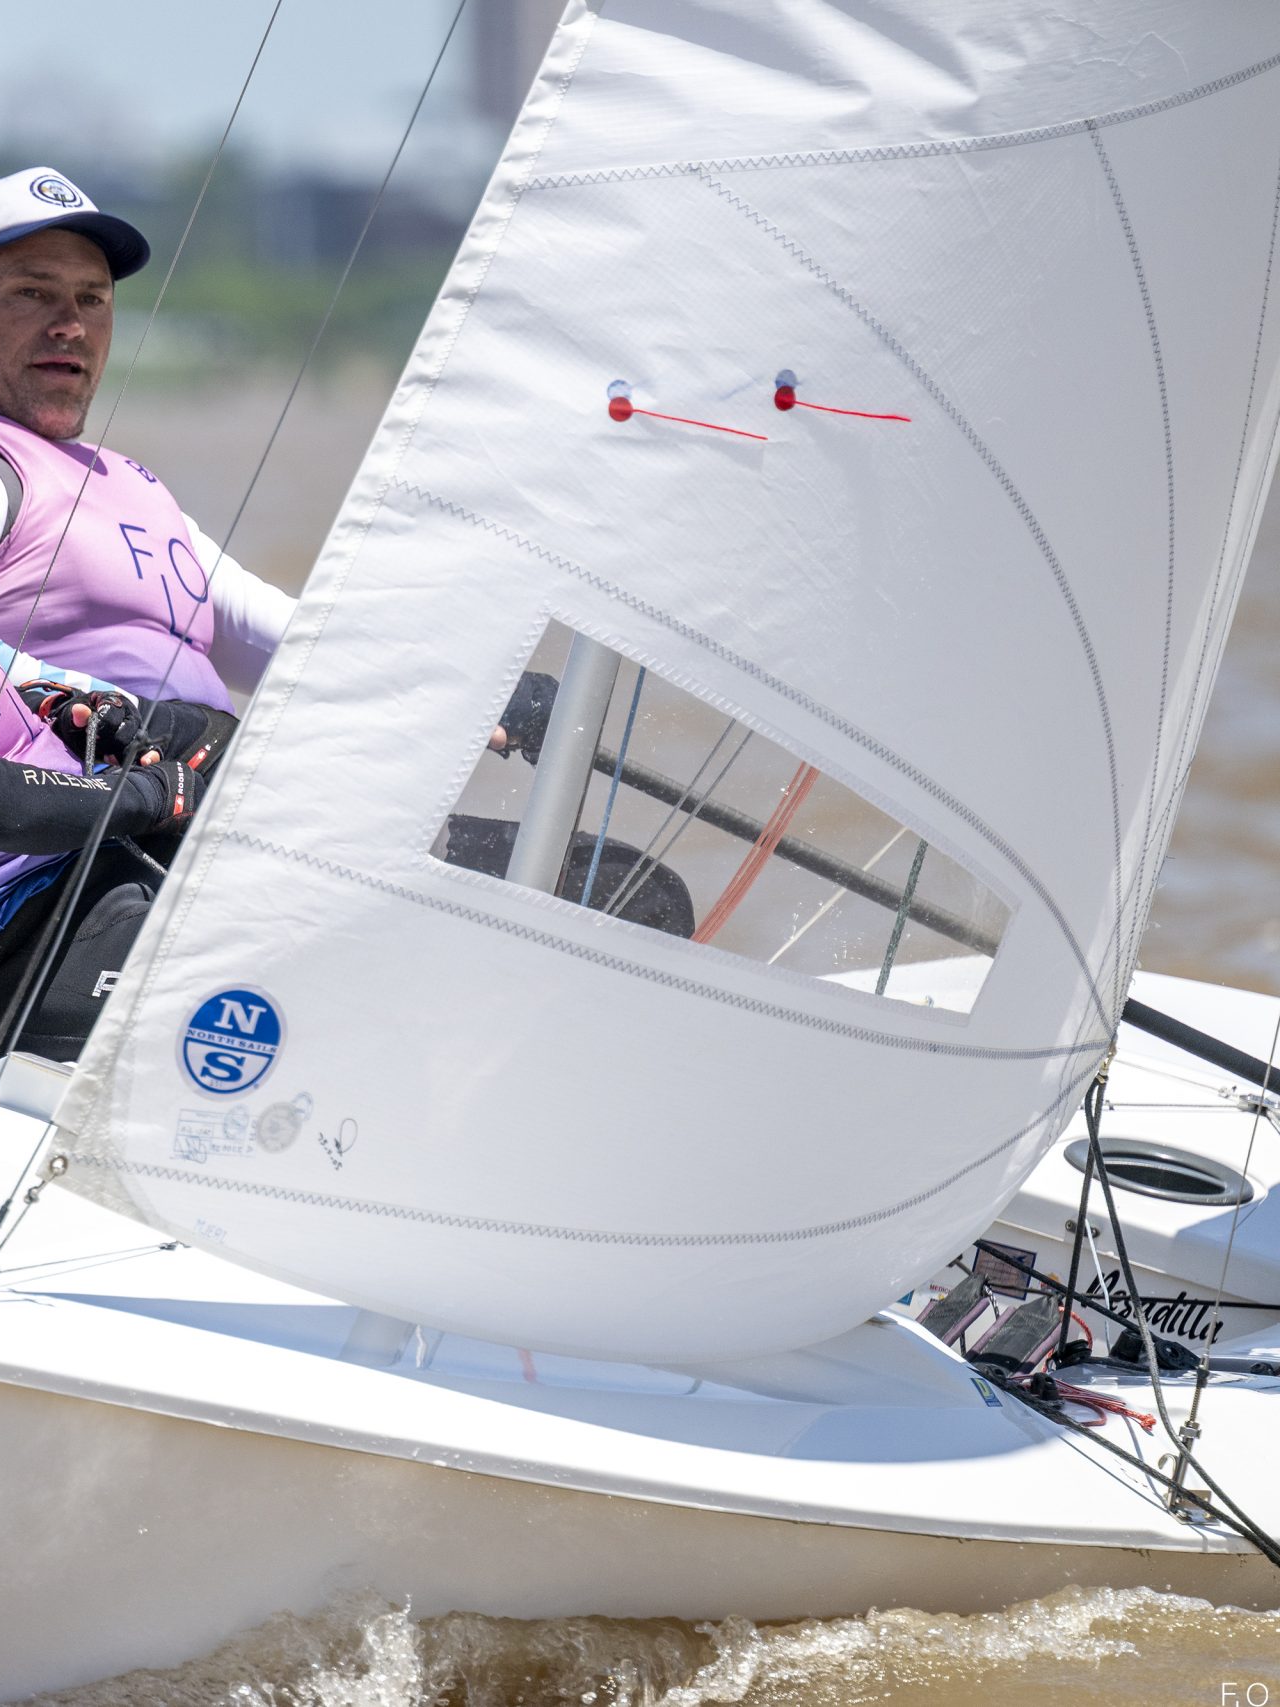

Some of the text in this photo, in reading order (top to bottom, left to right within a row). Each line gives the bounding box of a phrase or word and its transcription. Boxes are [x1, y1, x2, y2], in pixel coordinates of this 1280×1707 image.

[22, 769, 112, 791] RACELINE
[213, 998, 267, 1035] N
[186, 1029, 277, 1054] NORTH SAILS
[200, 1051, 246, 1082] S
